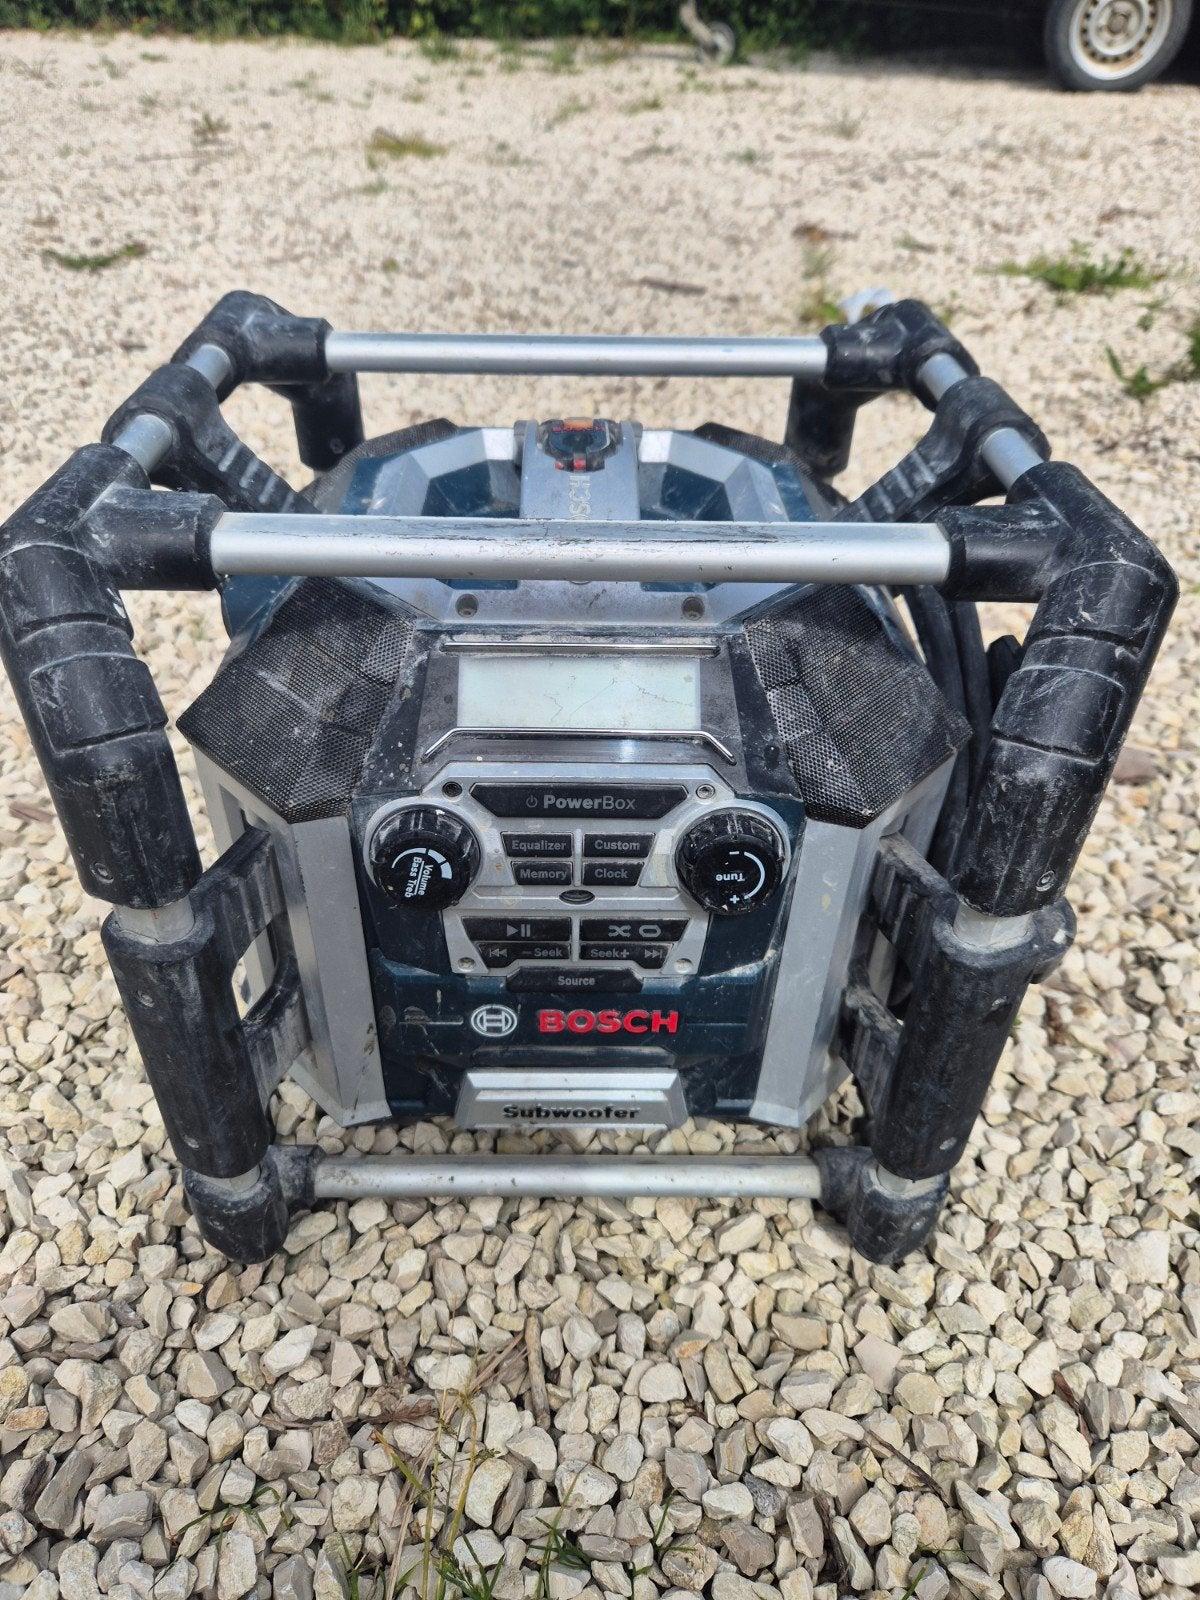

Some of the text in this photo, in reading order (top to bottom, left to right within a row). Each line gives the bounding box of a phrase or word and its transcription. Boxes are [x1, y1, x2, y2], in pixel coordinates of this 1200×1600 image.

[569, 475, 591, 519] SCH
[543, 794, 636, 810] PowerBox
[511, 840, 567, 851] Equalizer
[594, 839, 640, 851] Custom
[404, 856, 422, 898] Bass Treb
[418, 864, 434, 896] Volume
[520, 868, 567, 880] Memory
[594, 868, 628, 879] Clock
[715, 872, 745, 882] Tune
[558, 976, 595, 986] Source
[538, 1009, 679, 1033] BOSCH
[503, 1105, 640, 1119] Subwoofer
